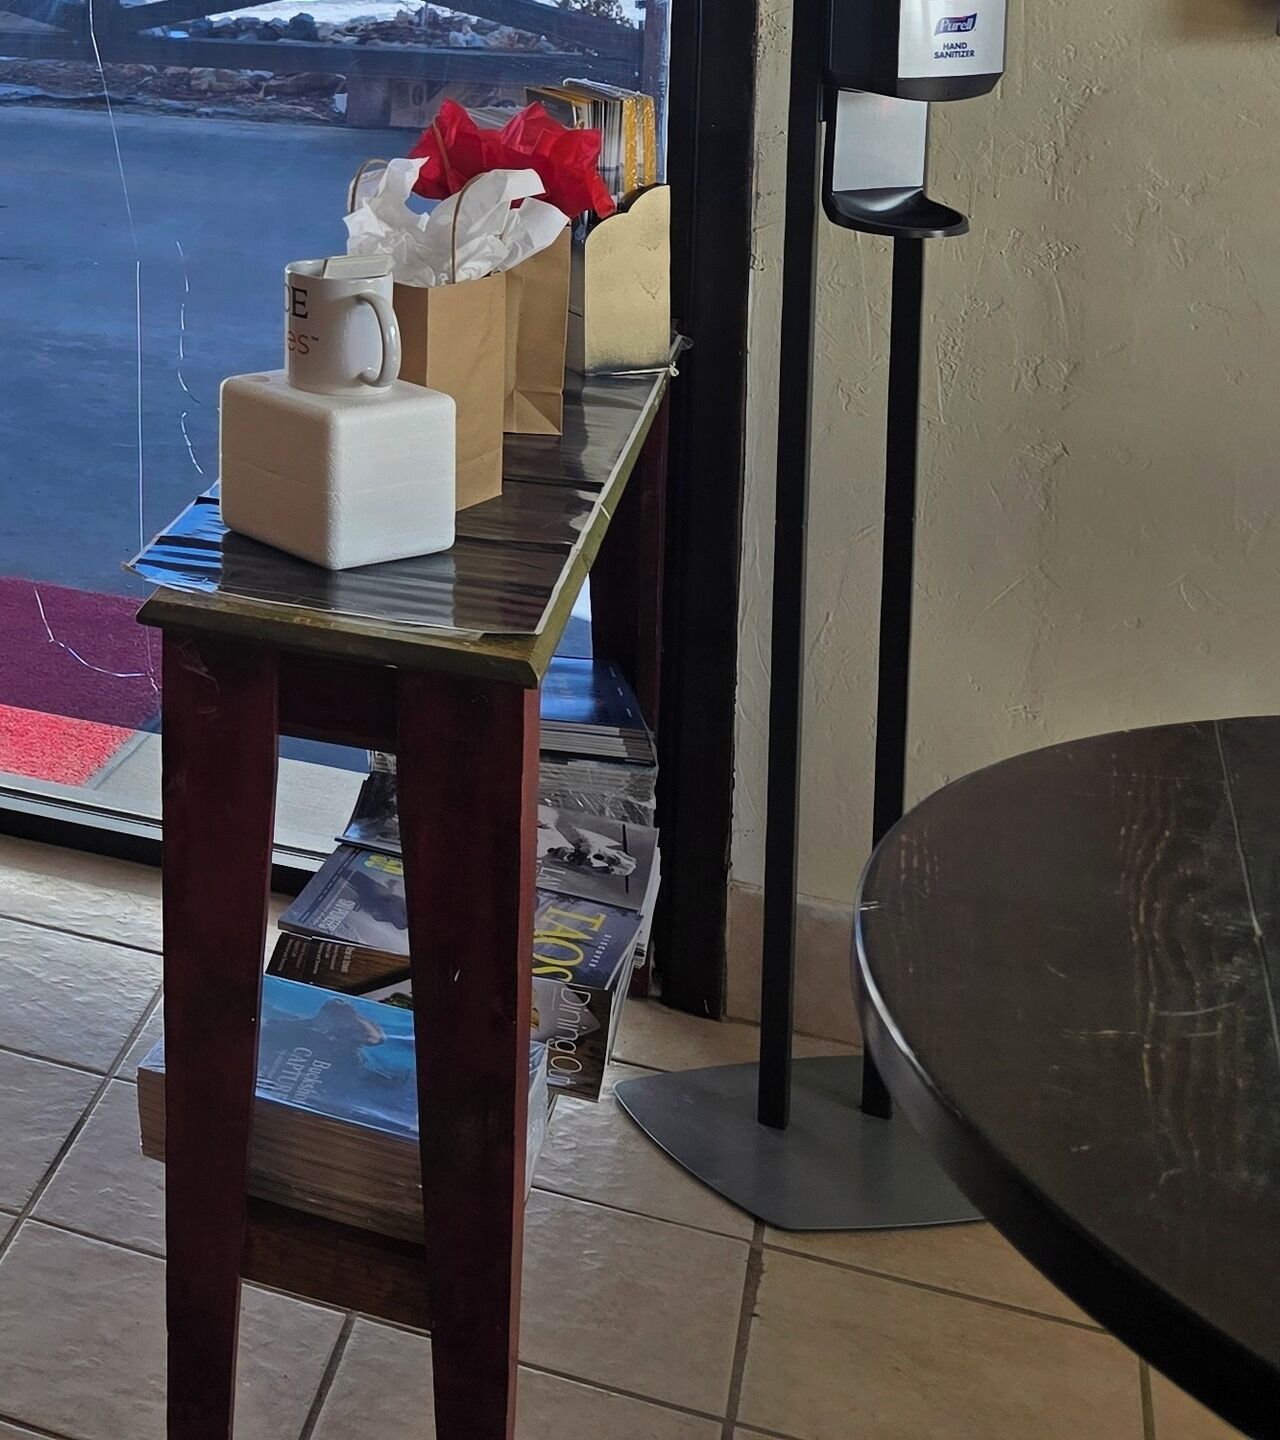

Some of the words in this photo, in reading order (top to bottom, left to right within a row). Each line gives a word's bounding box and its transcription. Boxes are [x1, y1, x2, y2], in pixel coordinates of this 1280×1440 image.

[940, 18, 974, 31] Purell
[943, 42, 968, 50] HAND
[934, 50, 976, 59] SANITIZER
